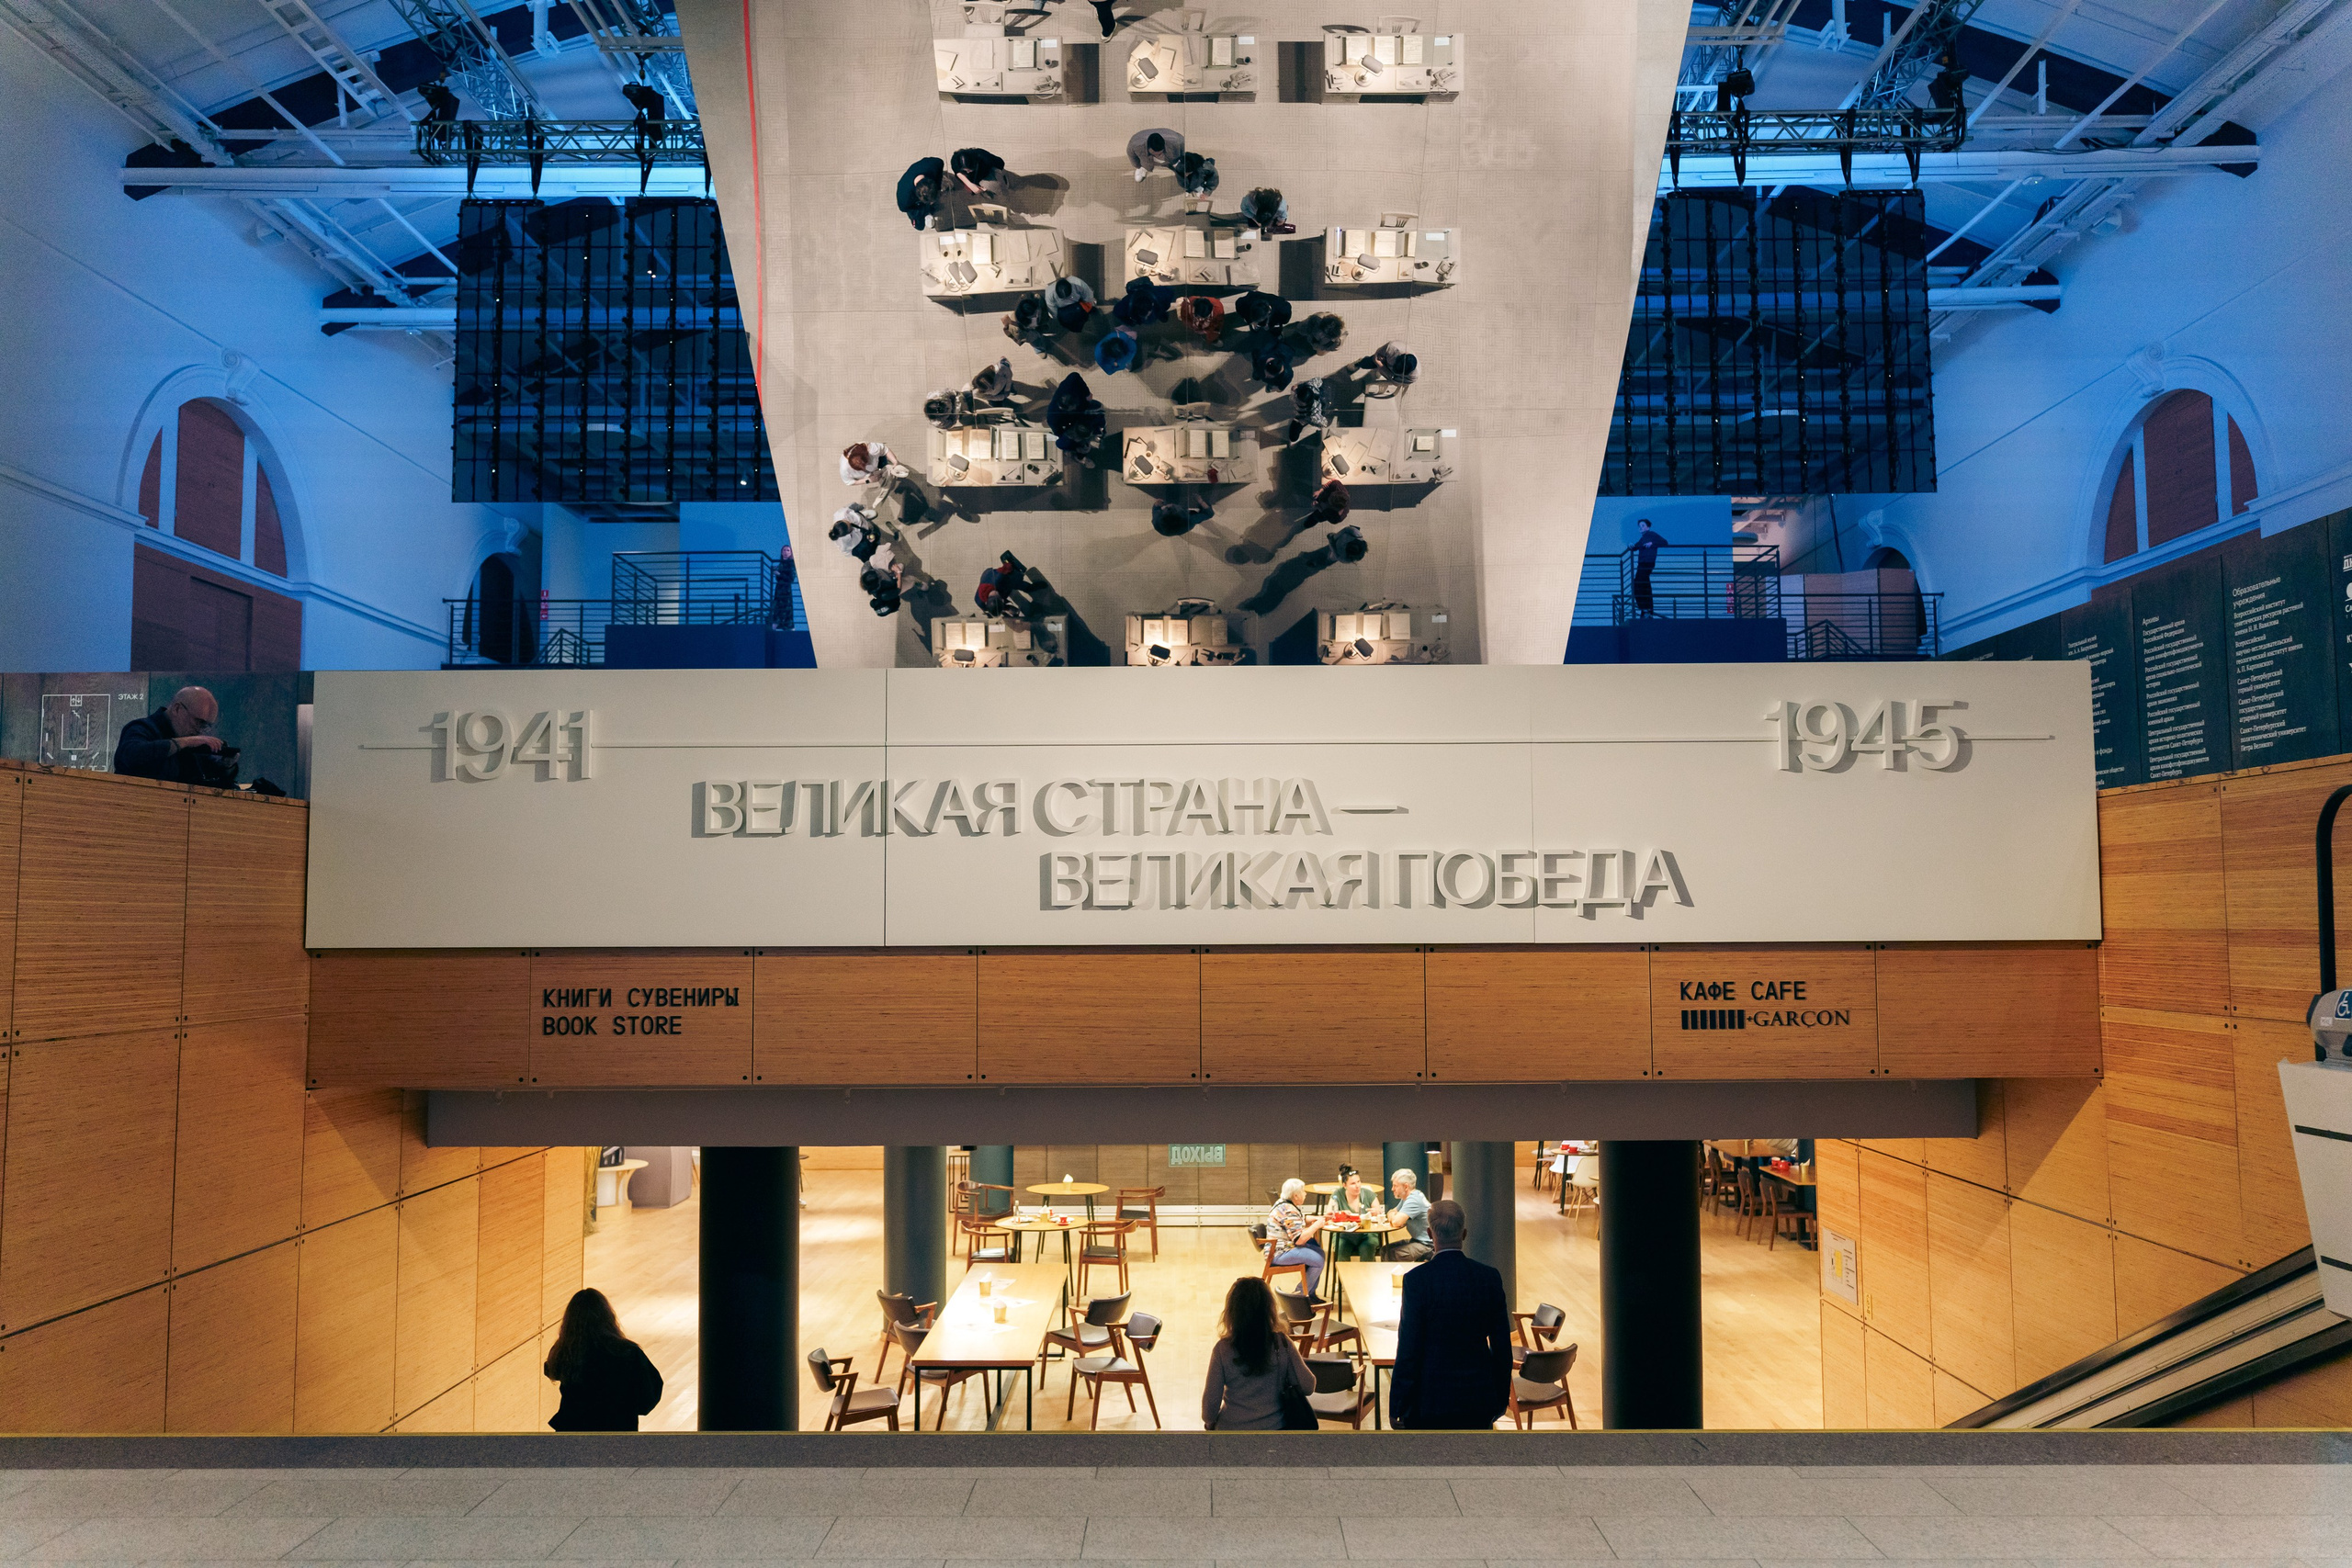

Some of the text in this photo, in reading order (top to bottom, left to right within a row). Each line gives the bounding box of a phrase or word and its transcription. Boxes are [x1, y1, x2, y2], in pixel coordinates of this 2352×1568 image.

[2233, 577, 2281, 597] Образовательные
[2233, 592, 2266, 610] учреждения
[2143, 615, 2160, 627] Архивы
[432, 708, 594, 781] 1941
[1764, 698, 1961, 771] 1945
[697, 779, 1023, 836] ВЕЛИКАЯ
[1038, 777, 1329, 835] СТРАНА
[1046, 848, 1687, 918] ВЕЛИКАЯ ПОБЕДА
[543, 987, 740, 1008] КНИГИ СУВЕНИРЫ
[1680, 981, 1806, 1000] КАФЕ CAFE
[543, 1016, 682, 1035] BOOK STORE
